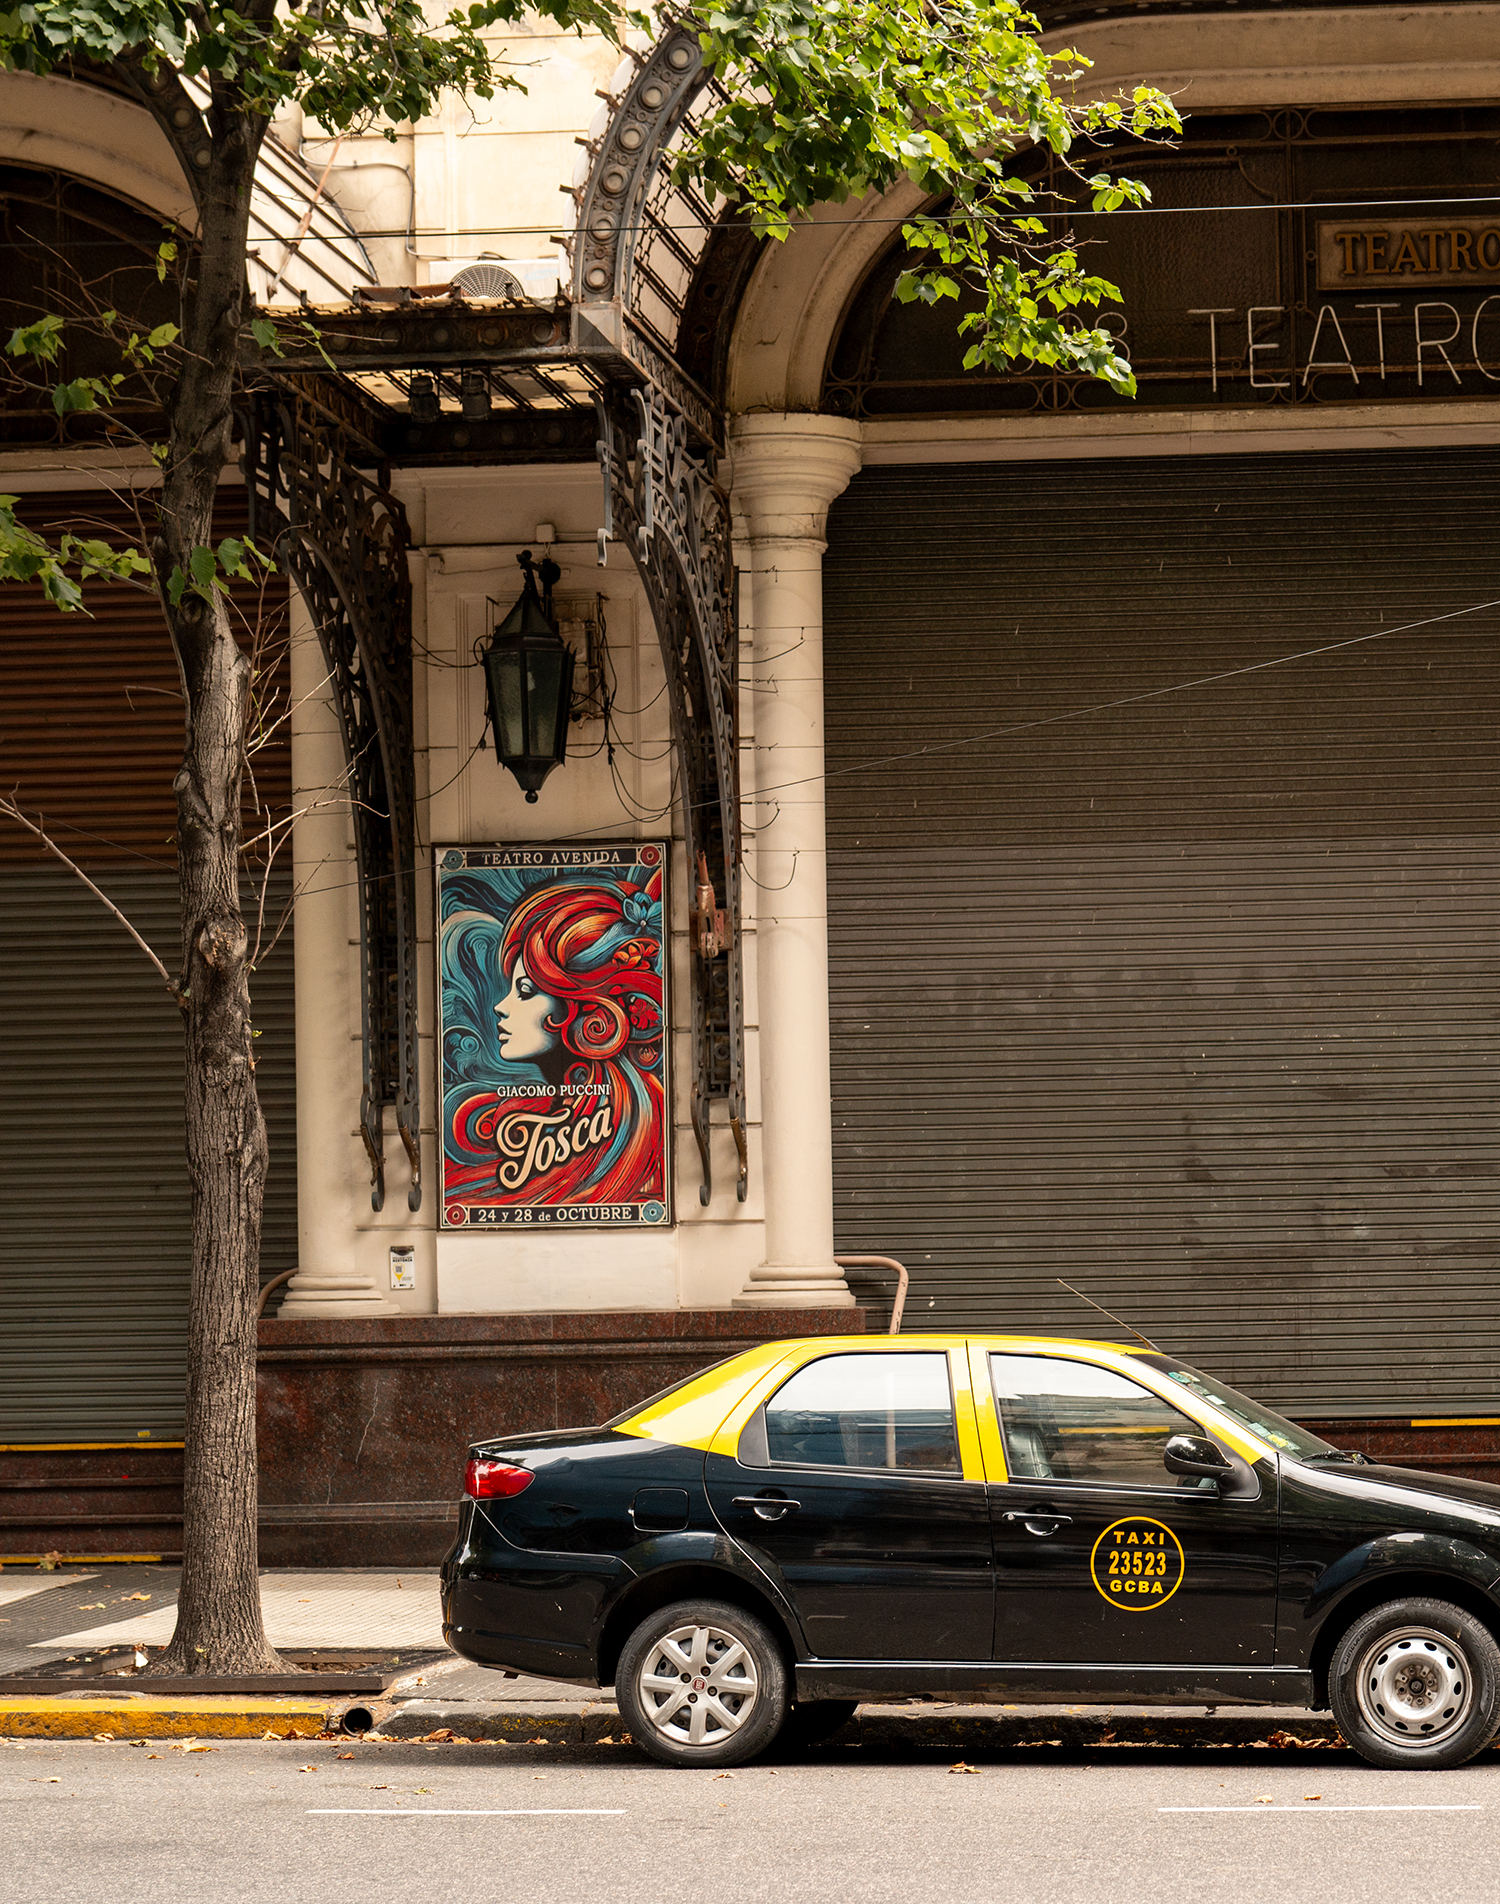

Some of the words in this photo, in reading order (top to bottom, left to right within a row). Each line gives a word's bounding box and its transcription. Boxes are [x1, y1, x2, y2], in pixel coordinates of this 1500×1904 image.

[481, 852, 543, 865] TEATRO
[550, 851, 621, 864] AVENIDA
[497, 1085, 556, 1097] GIACOMO
[560, 1084, 611, 1096] PUCCINI
[496, 1107, 612, 1190] Tosca
[478, 1209, 496, 1222] 24
[502, 1211, 509, 1222] y
[514, 1209, 533, 1222] 28
[538, 1212, 551, 1221] de
[556, 1207, 632, 1221] OCTUBRE
[1113, 1531, 1165, 1545] TAXI
[1108, 1550, 1167, 1576] 23523
[1109, 1579, 1164, 1594] GCBA
